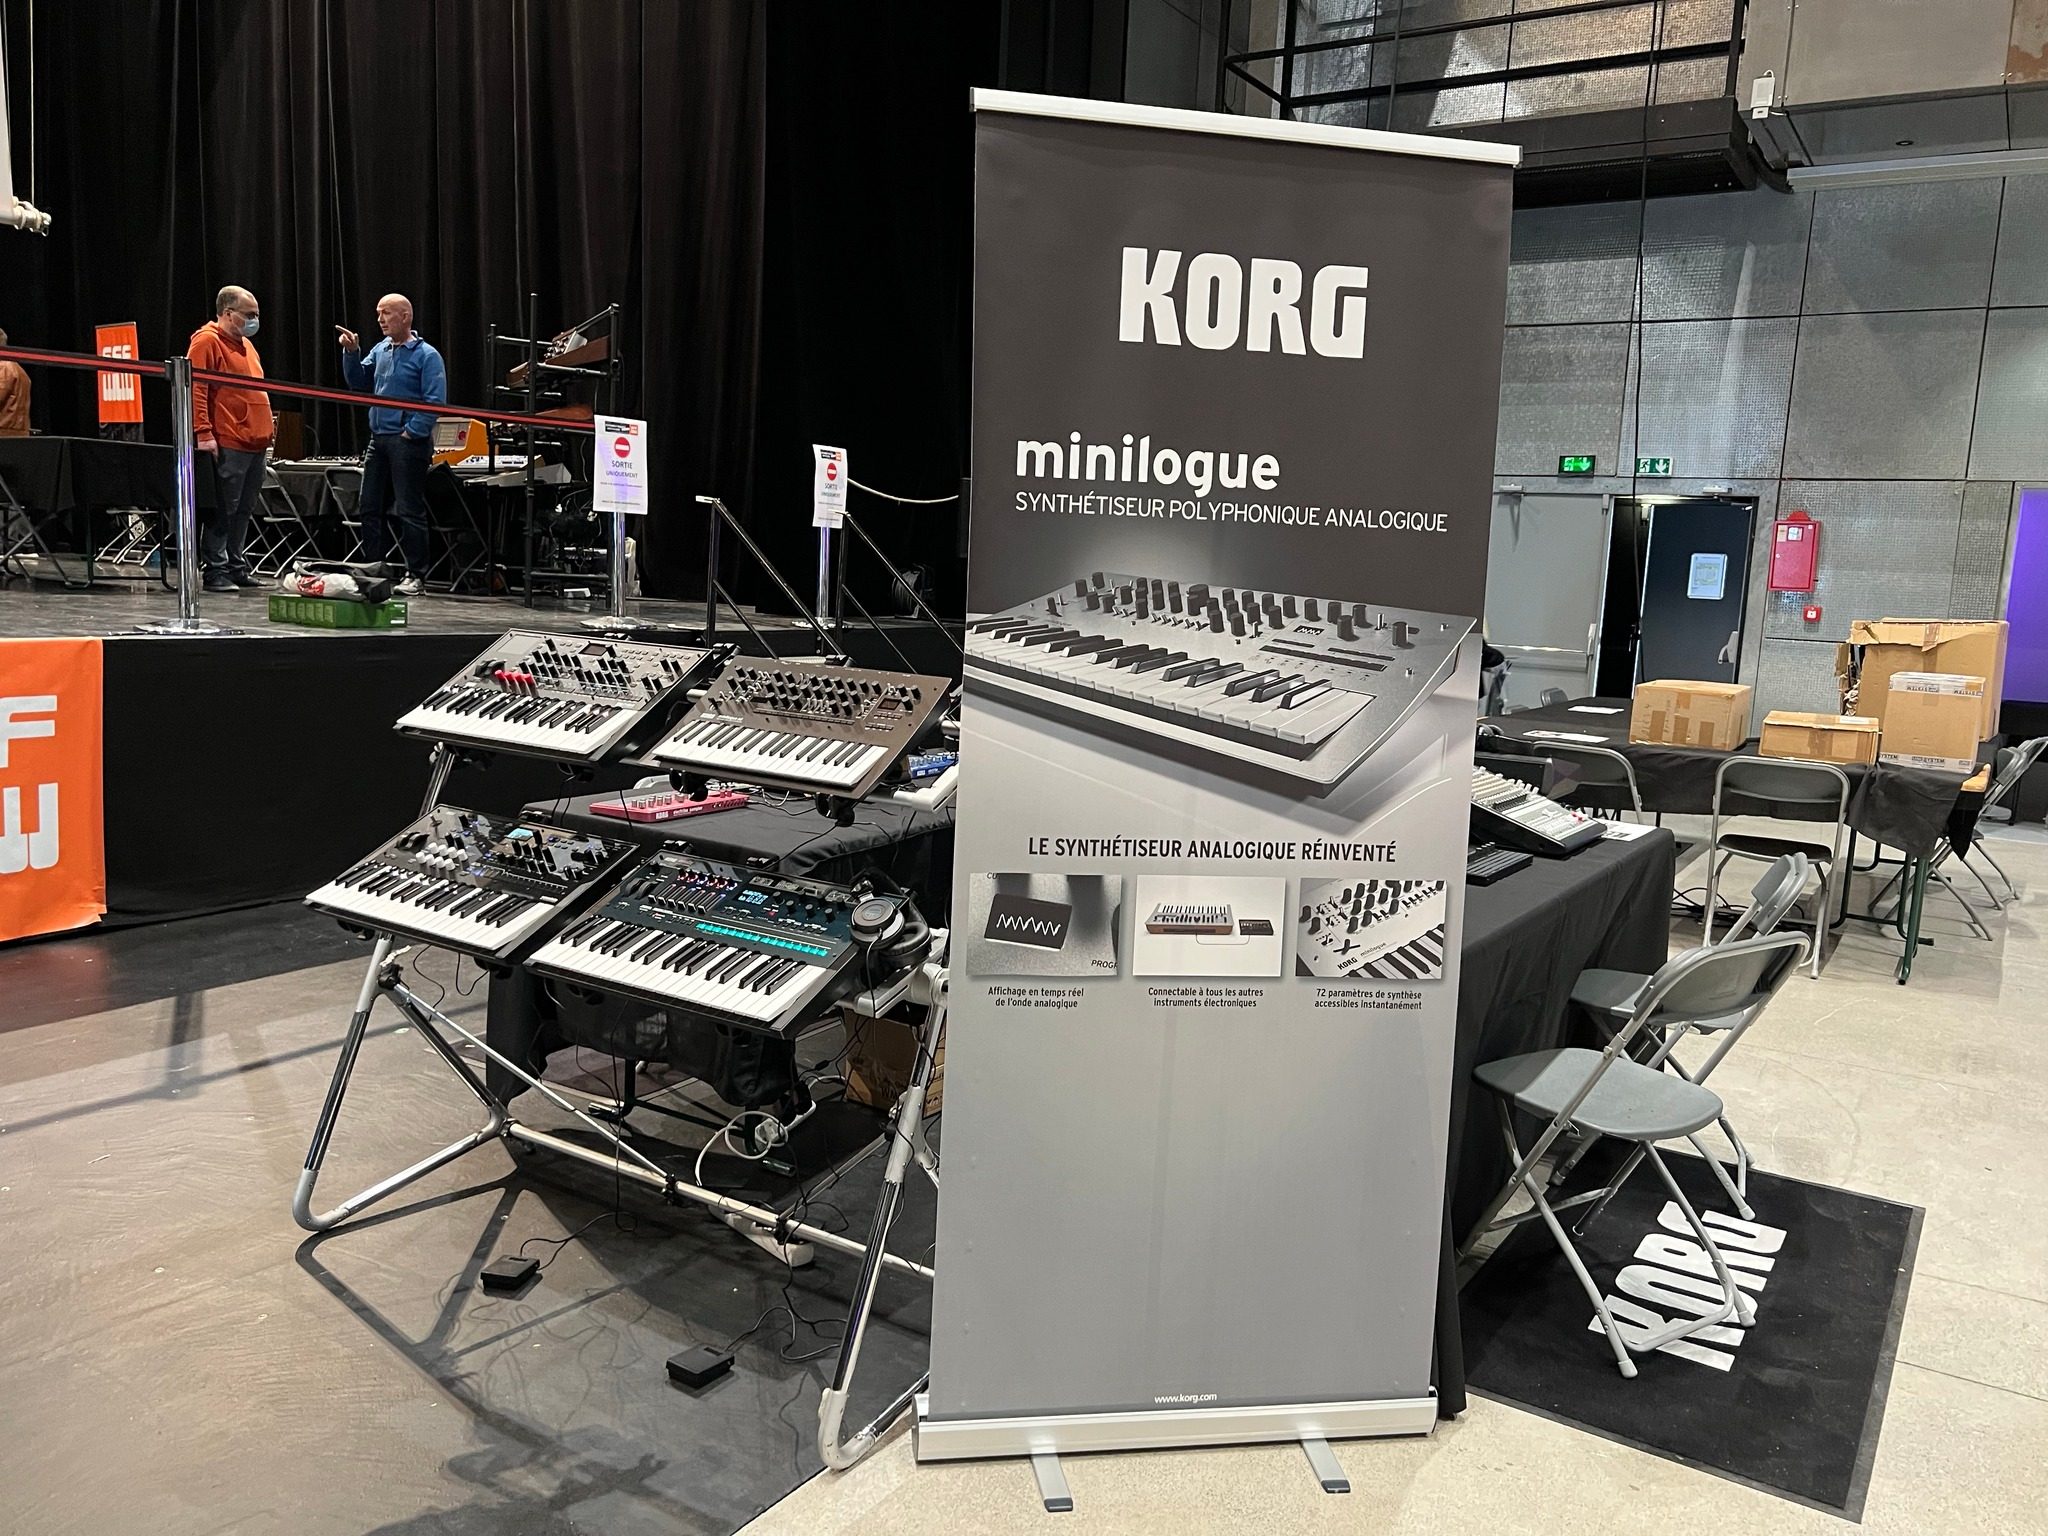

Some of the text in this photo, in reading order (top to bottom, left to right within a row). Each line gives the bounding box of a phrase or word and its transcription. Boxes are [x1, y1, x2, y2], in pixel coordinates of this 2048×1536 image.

[1119, 246, 1369, 359] KORG
[611, 460, 633, 469] SORTIE
[1015, 431, 1281, 498] minilogue
[1015, 490, 1449, 532] SYNTHÉTISEUR POLYPHONIQUE ANALOGIQUE
[1029, 834, 1397, 862] LE SYNTHÉTISEUR ANALOGIQUE RÉINVENTÉ
[1337, 957, 1359, 971] KORG
[988, 987, 1027, 997] Affichage
[1041, 988, 1066, 998] temps
[1068, 987, 1084, 996] réel
[1148, 987, 1264, 997] Connectable à tous les autres
[1316, 988, 1422, 1000] 72 paramètres de synthèse
[995, 998, 1078, 1009] de l'onde analogique
[1154, 997, 1257, 1009] instruments électroniques
[1314, 999, 1422, 1010] accessibles instantanément
[1587, 1200, 1787, 1372] KORG
[1154, 1393, 1218, 1404] www.korg.com
